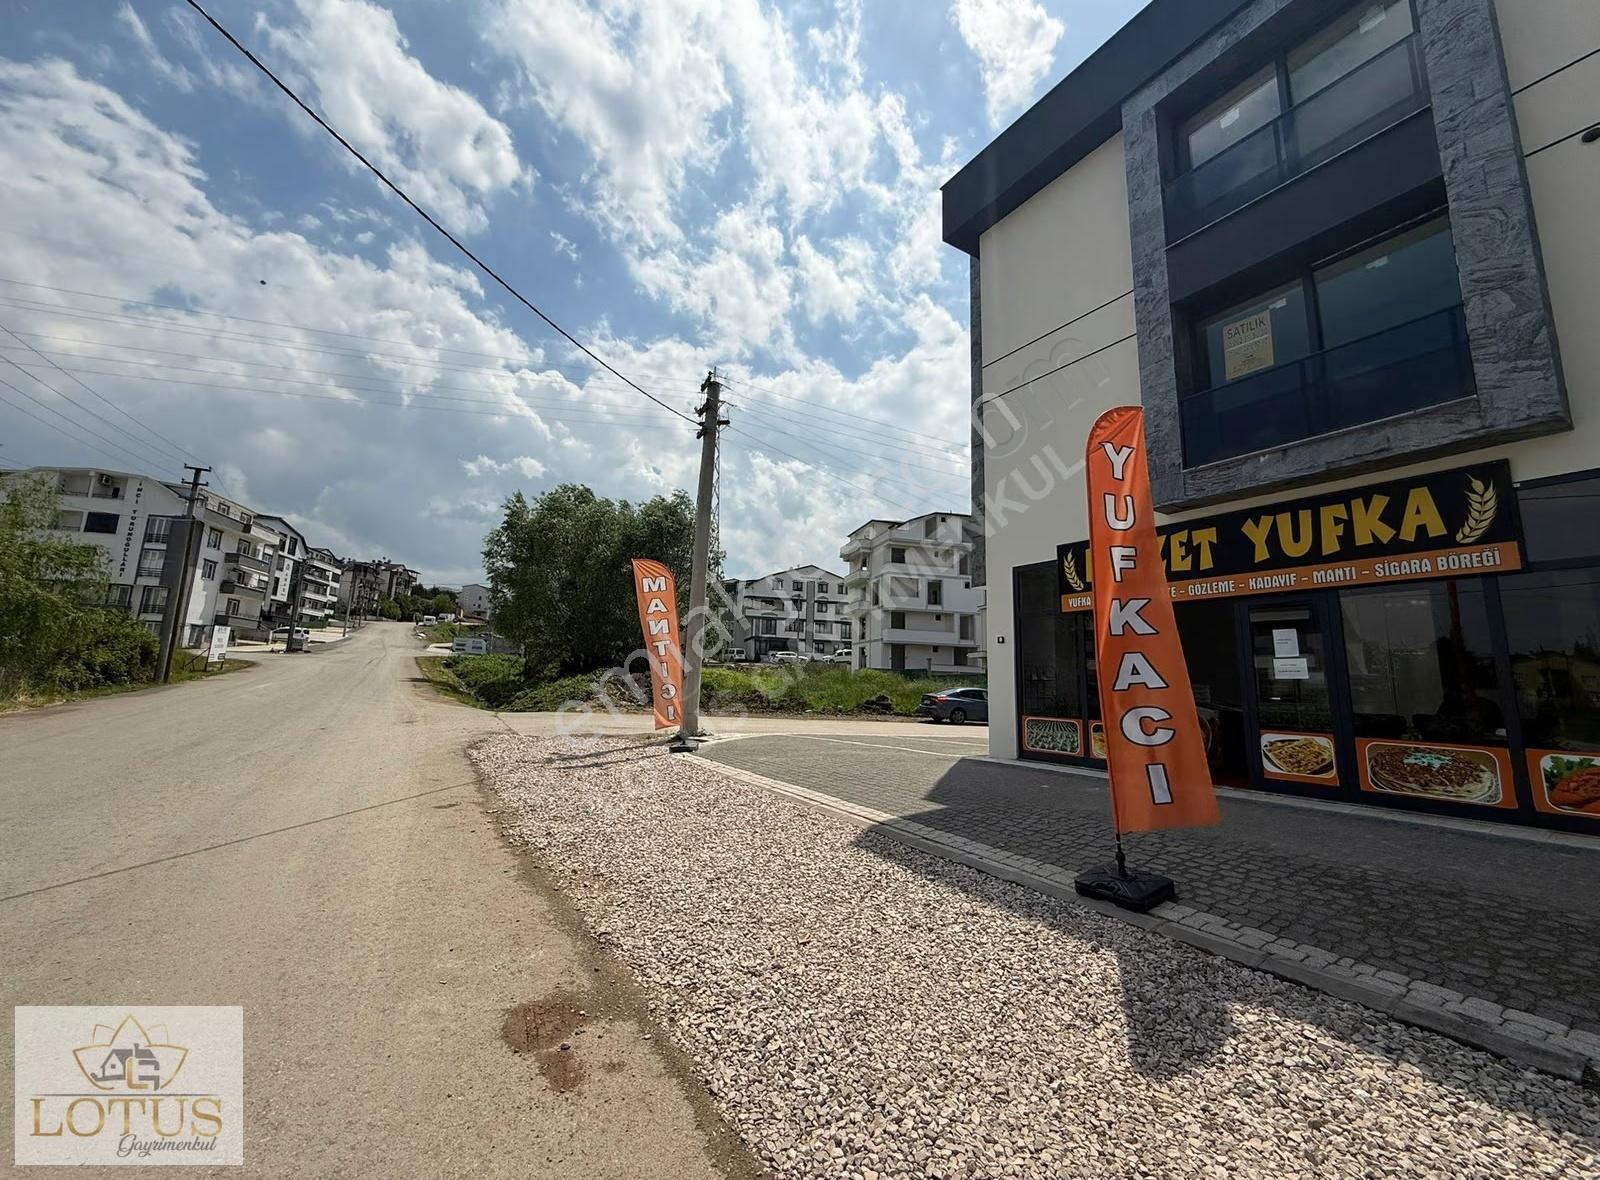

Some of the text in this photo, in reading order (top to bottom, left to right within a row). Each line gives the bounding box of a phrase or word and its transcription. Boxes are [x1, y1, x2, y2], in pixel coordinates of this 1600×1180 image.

[1226, 316, 1266, 340] SATILIK
[1241, 486, 1448, 564] YUFKA
[1068, 595, 1092, 608] YUFKA
[1188, 580, 1236, 596] GÖZLEME
[1248, 573, 1297, 590] KADAYIF
[1313, 566, 1357, 584] MANTI
[1374, 559, 1432, 578] SİGARA
[1436, 546, 1501, 572] BÖREĞİ
[1099, 440, 1176, 805] YUFKACI
